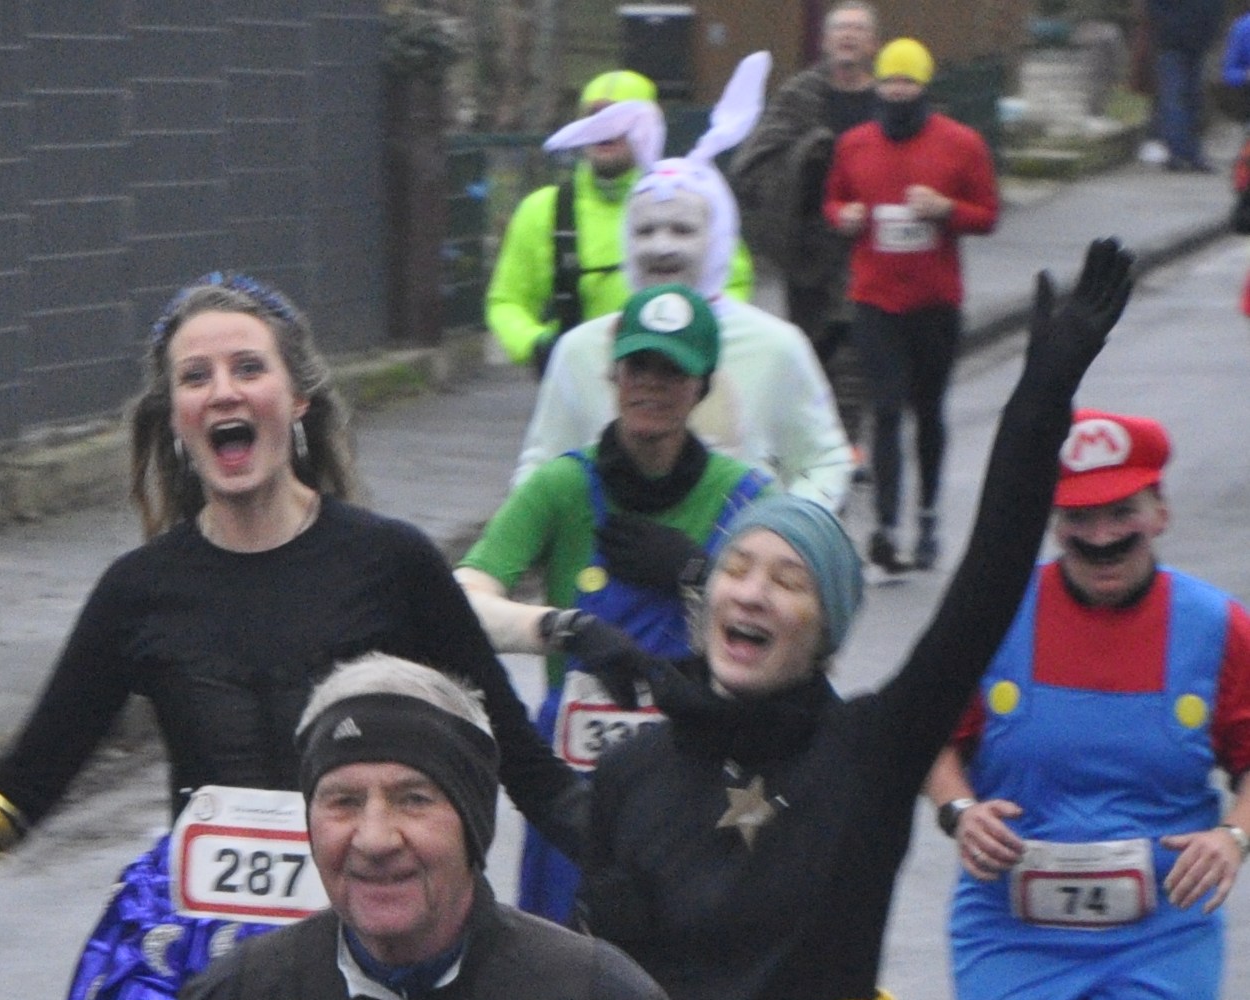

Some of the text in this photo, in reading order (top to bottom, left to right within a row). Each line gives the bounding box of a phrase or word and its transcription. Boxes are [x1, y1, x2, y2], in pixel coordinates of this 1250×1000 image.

[1069, 426, 1120, 461] M
[212, 847, 308, 898] 287
[1057, 886, 1109, 916] 74
